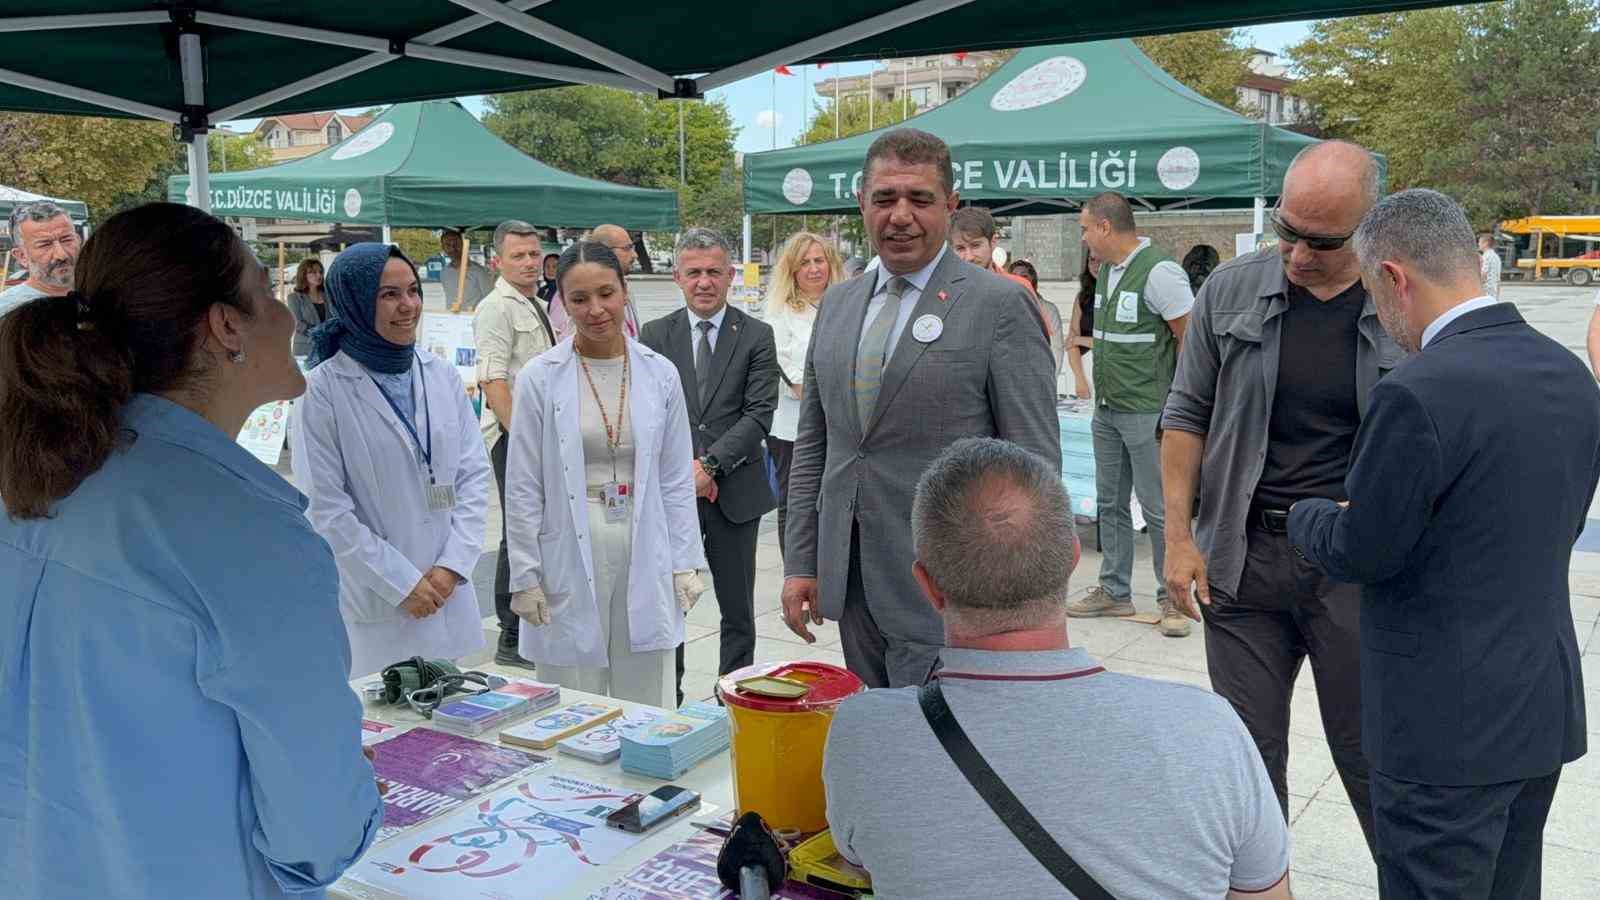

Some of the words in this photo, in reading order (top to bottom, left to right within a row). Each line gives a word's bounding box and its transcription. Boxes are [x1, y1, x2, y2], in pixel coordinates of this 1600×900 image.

[993, 151, 1137, 189] VALİLİĞİ
[209, 186, 272, 209] .C.DÜZCE
[275, 187, 336, 214] VALİLİĞİ
